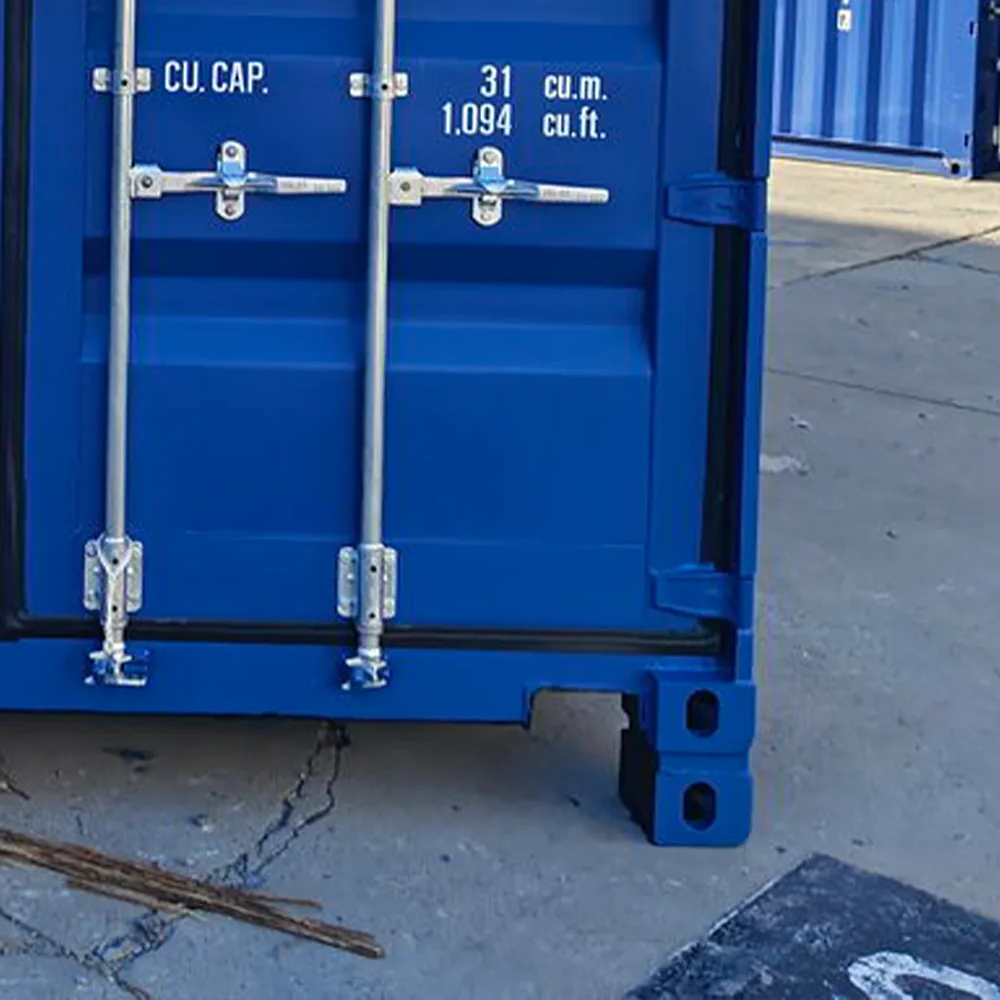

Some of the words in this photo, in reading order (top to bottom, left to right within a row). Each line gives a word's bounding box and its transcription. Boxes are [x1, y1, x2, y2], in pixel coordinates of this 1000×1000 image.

[480, 64, 511, 99] 31
[544, 72, 607, 101] cu.m.
[442, 103, 512, 137] 1.094
[542, 106, 606, 140] cu.ft.
